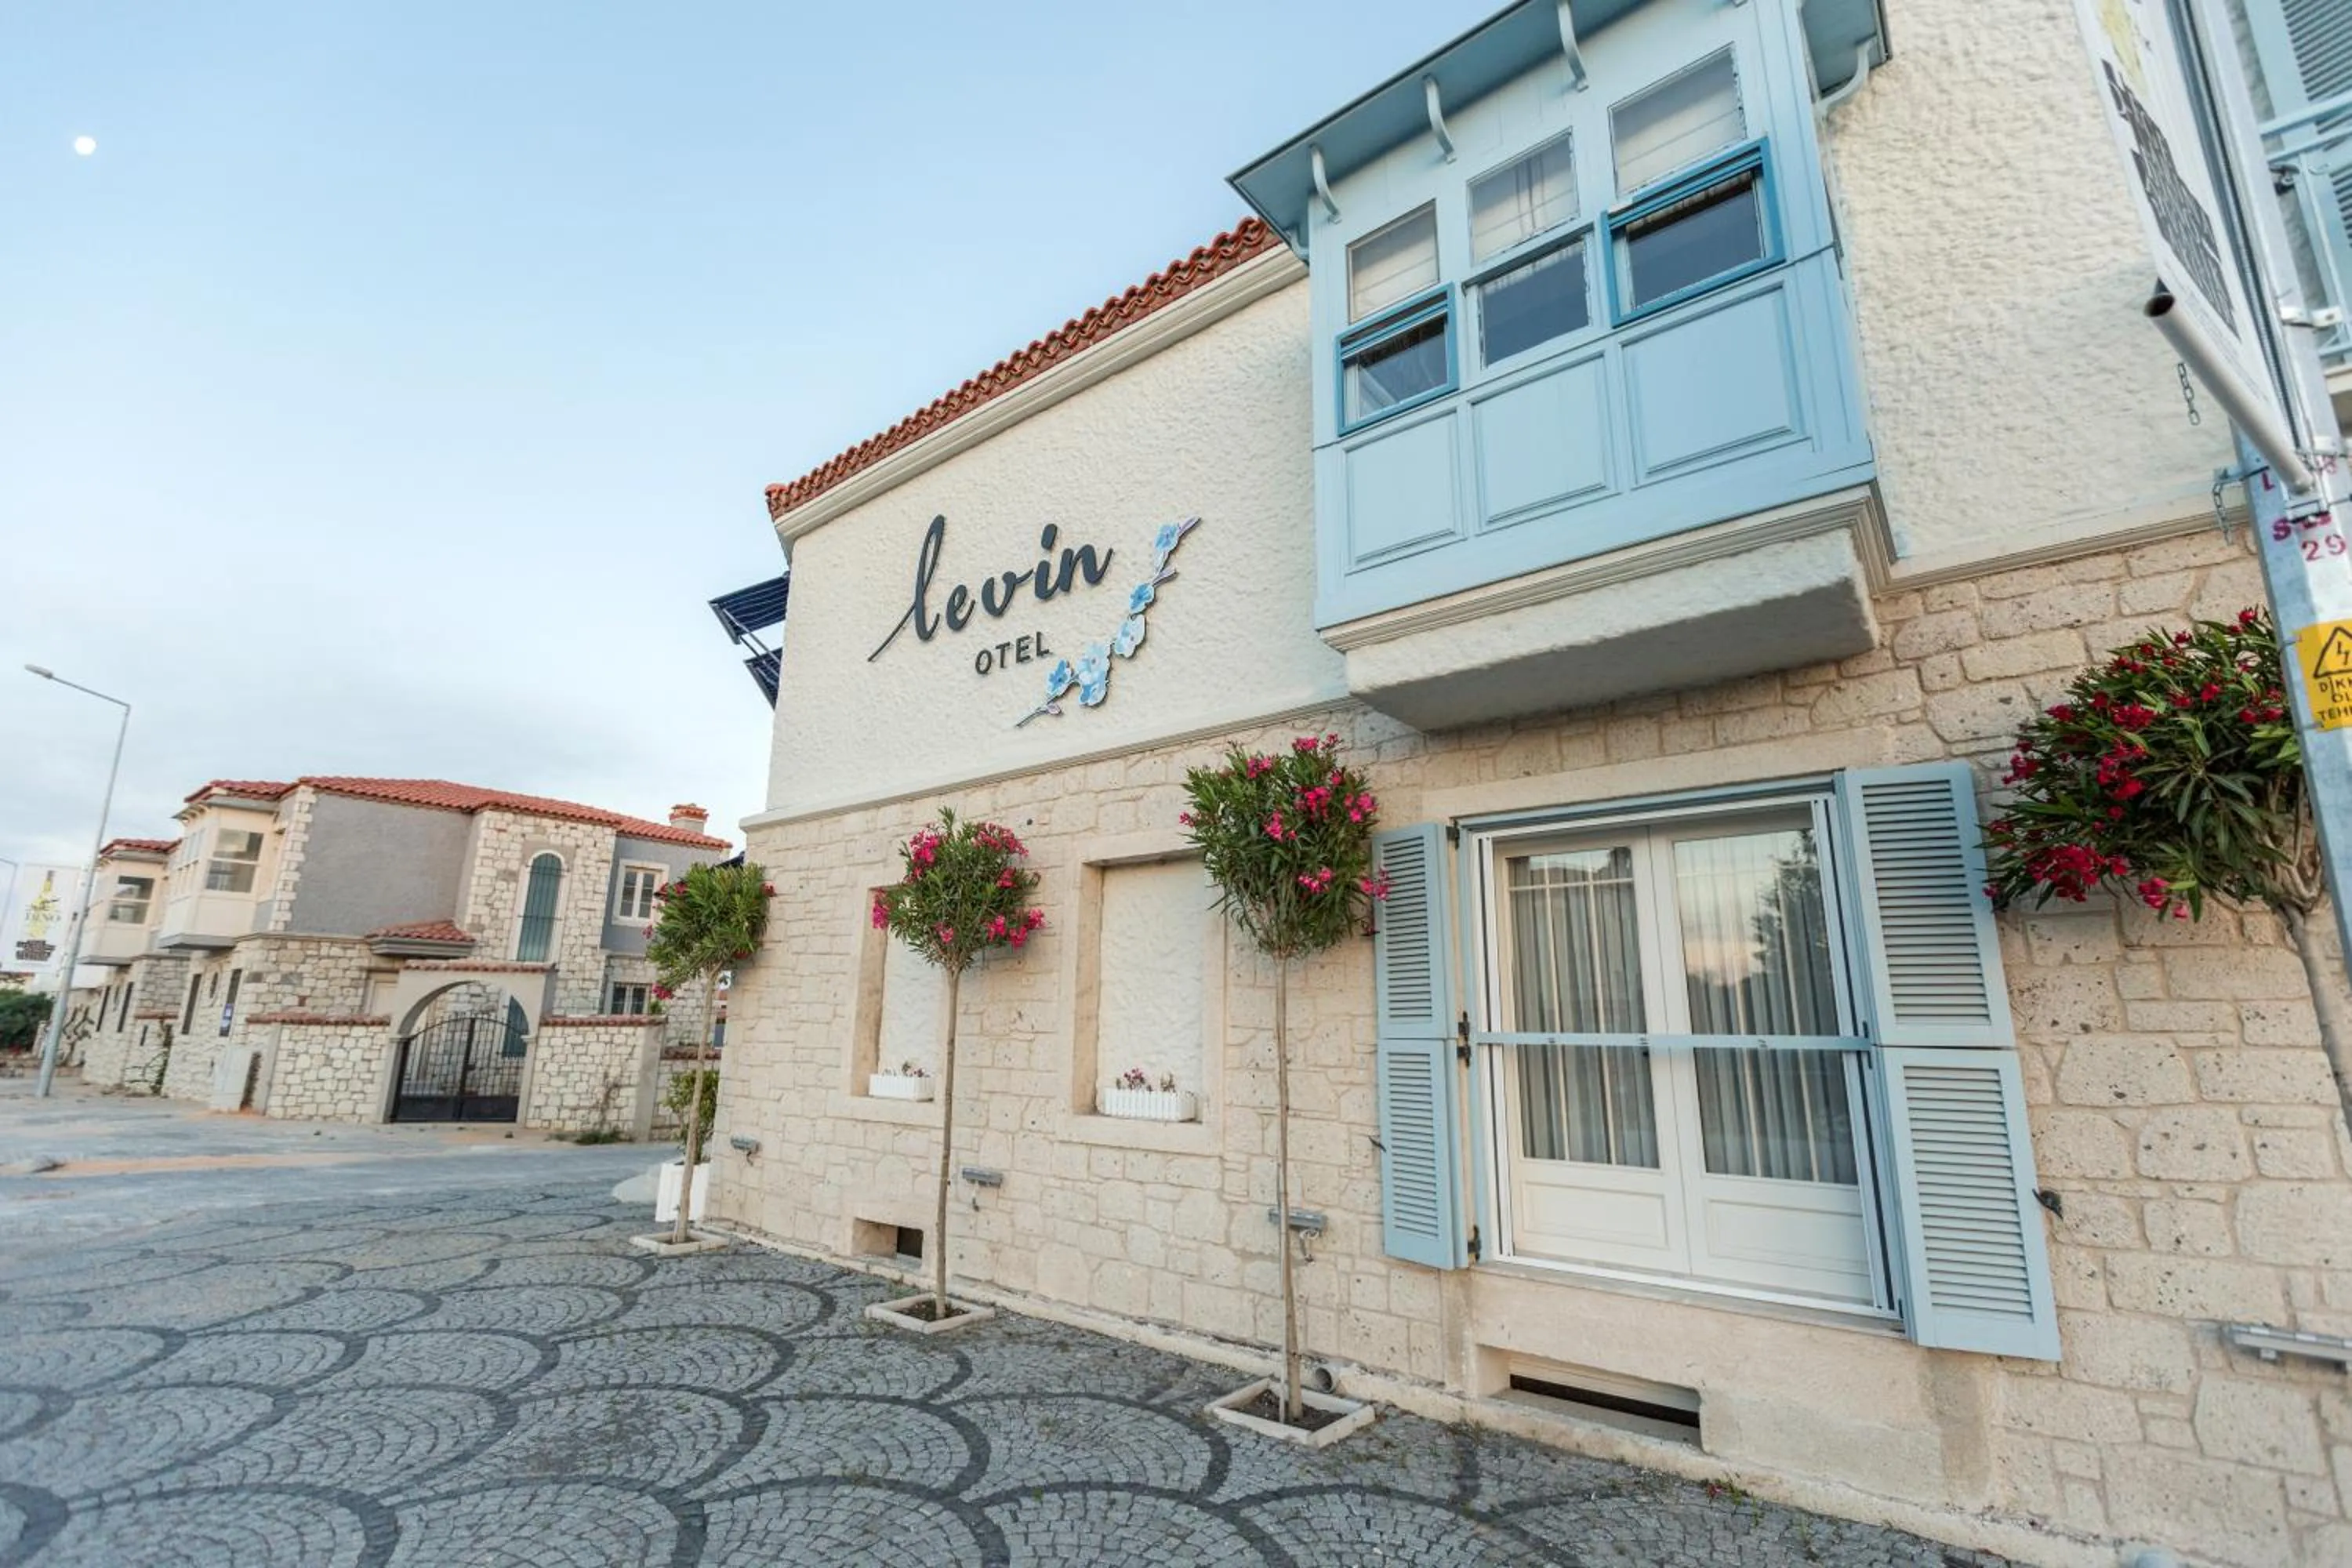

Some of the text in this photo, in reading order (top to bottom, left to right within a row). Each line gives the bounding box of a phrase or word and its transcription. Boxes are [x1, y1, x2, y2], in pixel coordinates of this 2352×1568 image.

[2302, 533, 2347, 561] 29
[867, 514, 1114, 662] levin
[975, 631, 1051, 675] OTEL
